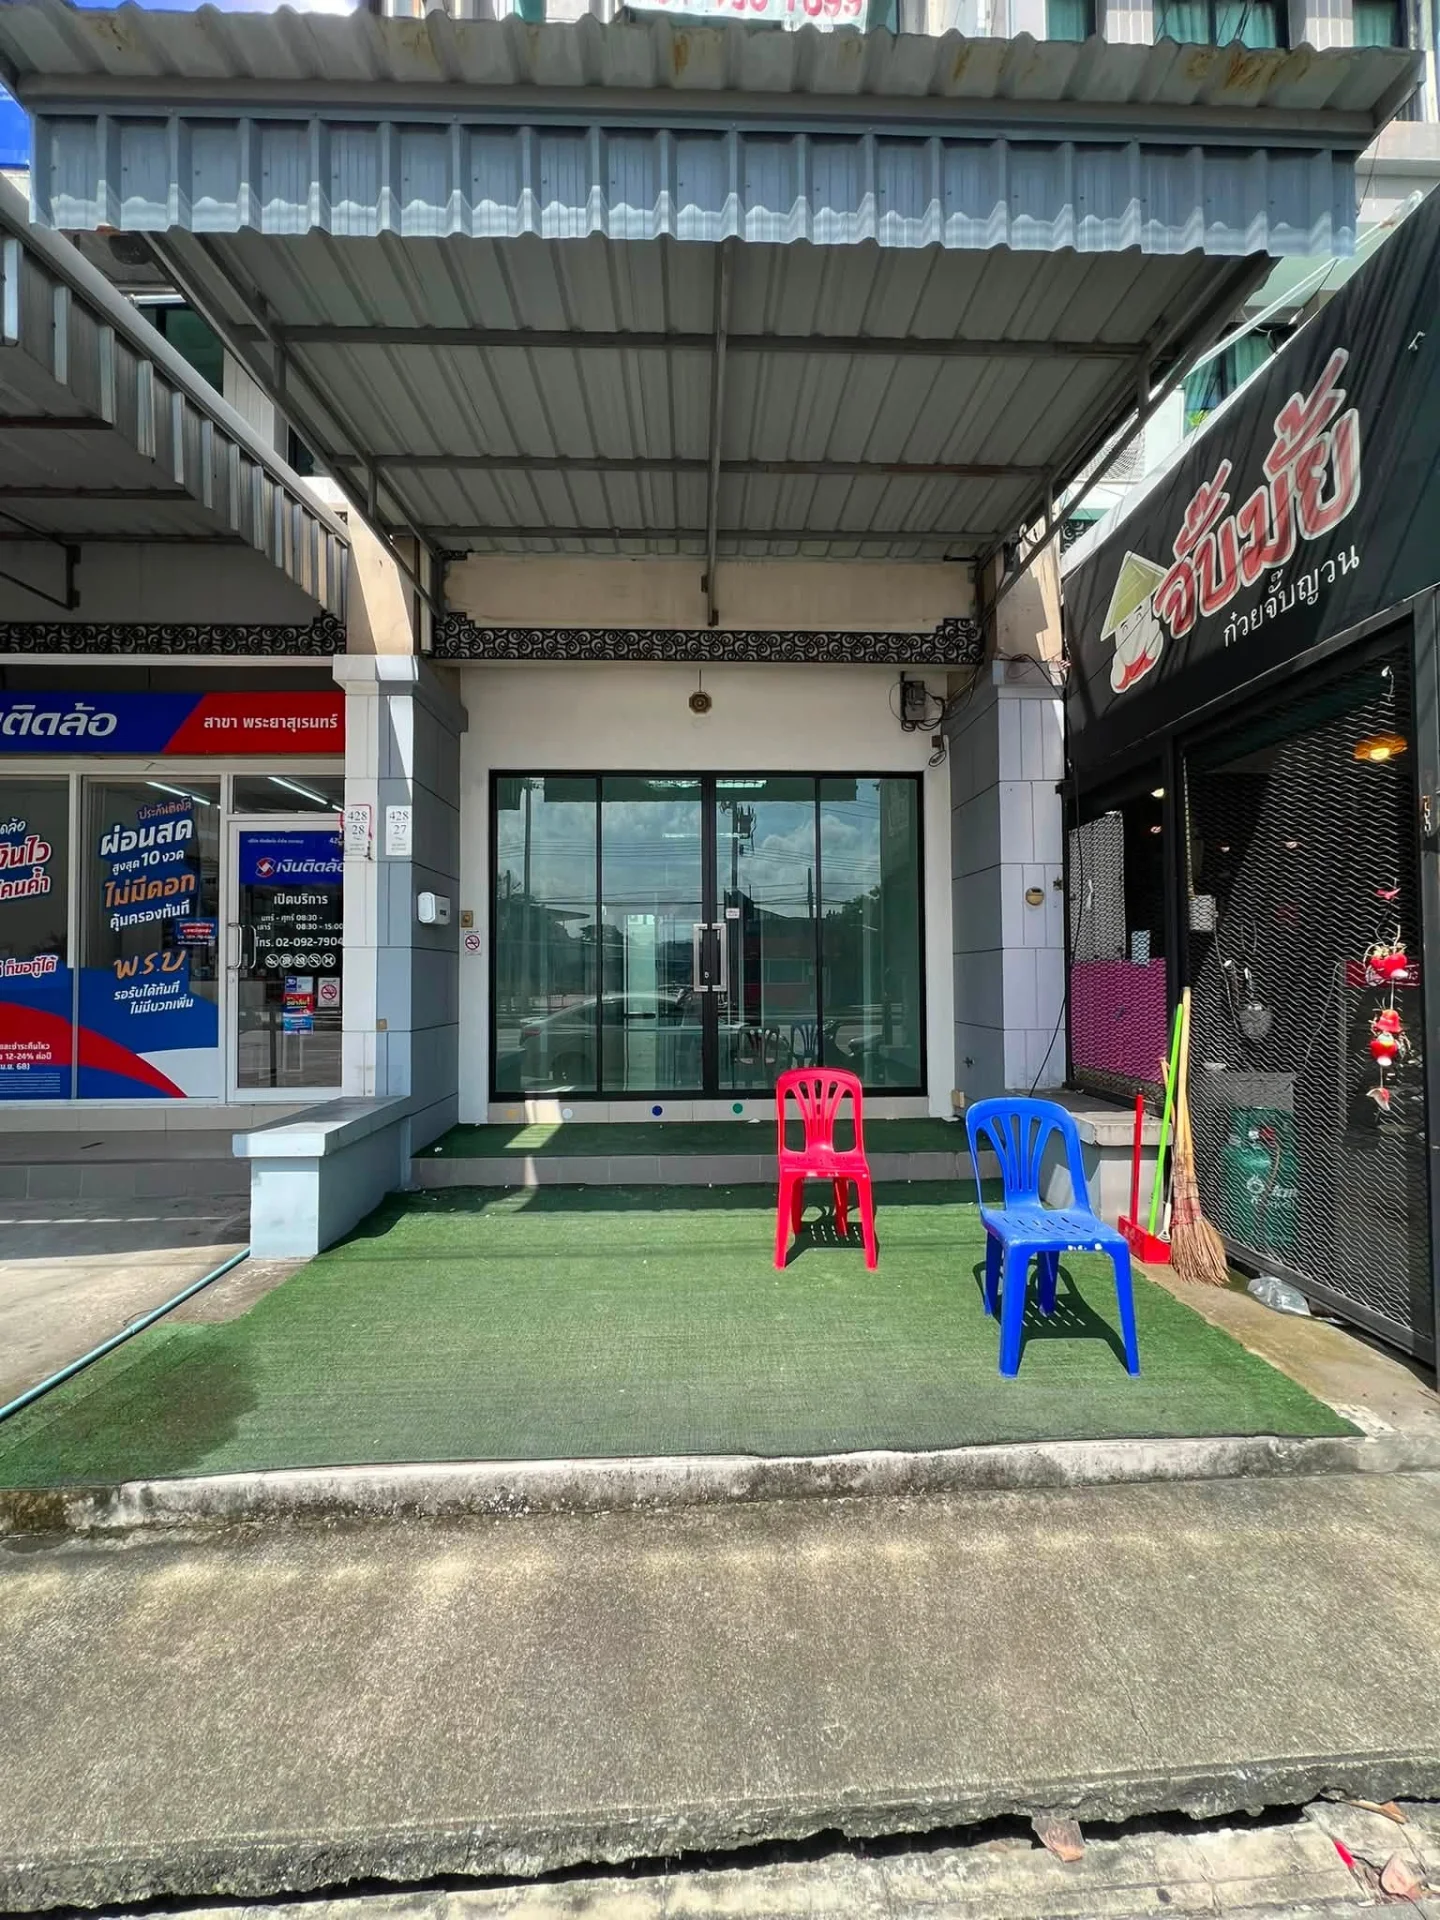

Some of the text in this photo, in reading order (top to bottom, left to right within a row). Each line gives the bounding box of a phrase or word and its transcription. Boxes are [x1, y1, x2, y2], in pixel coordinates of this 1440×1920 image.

[0, 702, 118, 736] ติดล้อ
[203, 713, 338, 733] สาขา พระยาสุเรนทร์
[347, 810, 368, 821] 428
[389, 810, 410, 821] 428
[100, 818, 194, 856] ผ่อนสด
[352, 824, 365, 835] 28
[393, 824, 407, 835] 27
[112, 848, 185, 876] สูงสุด 10 งวด
[104, 873, 196, 908] ไม่มีดอก
[273, 892, 329, 905] เปิดบริการ
[109, 898, 191, 932] คุ้มครองทันที
[113, 980, 181, 1001] รอรับได้ทันที
[130, 993, 194, 1015] ไม่มีบวกเพิ่ม
